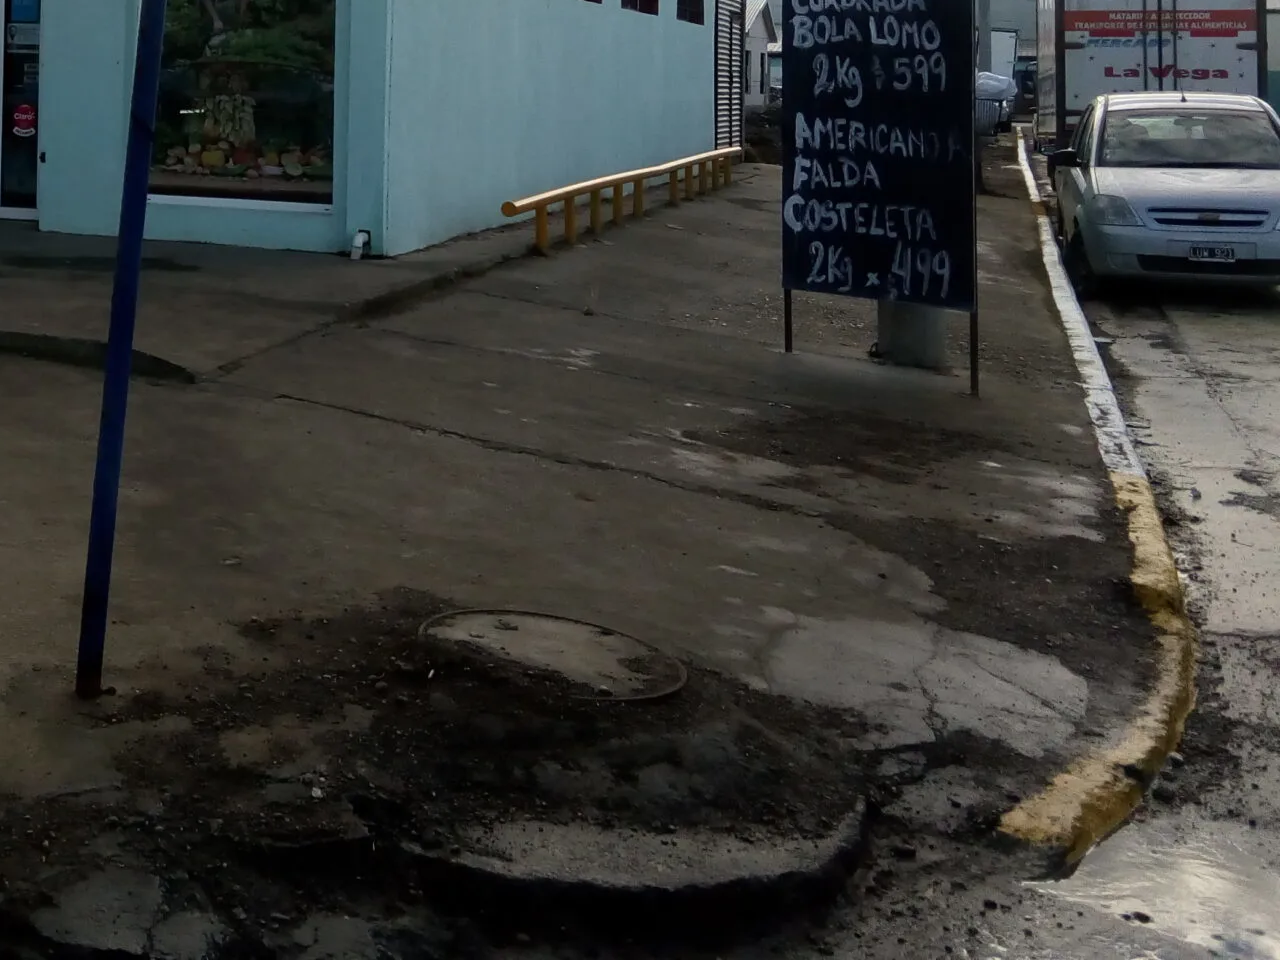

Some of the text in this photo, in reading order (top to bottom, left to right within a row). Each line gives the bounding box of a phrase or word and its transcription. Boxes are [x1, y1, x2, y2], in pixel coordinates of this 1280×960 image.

[789, 14, 941, 51] BOLA LOMO
[1104, 64, 1229, 80] La Vega
[792, 153, 883, 191] FALDA
[783, 193, 937, 242] COSTELETA
